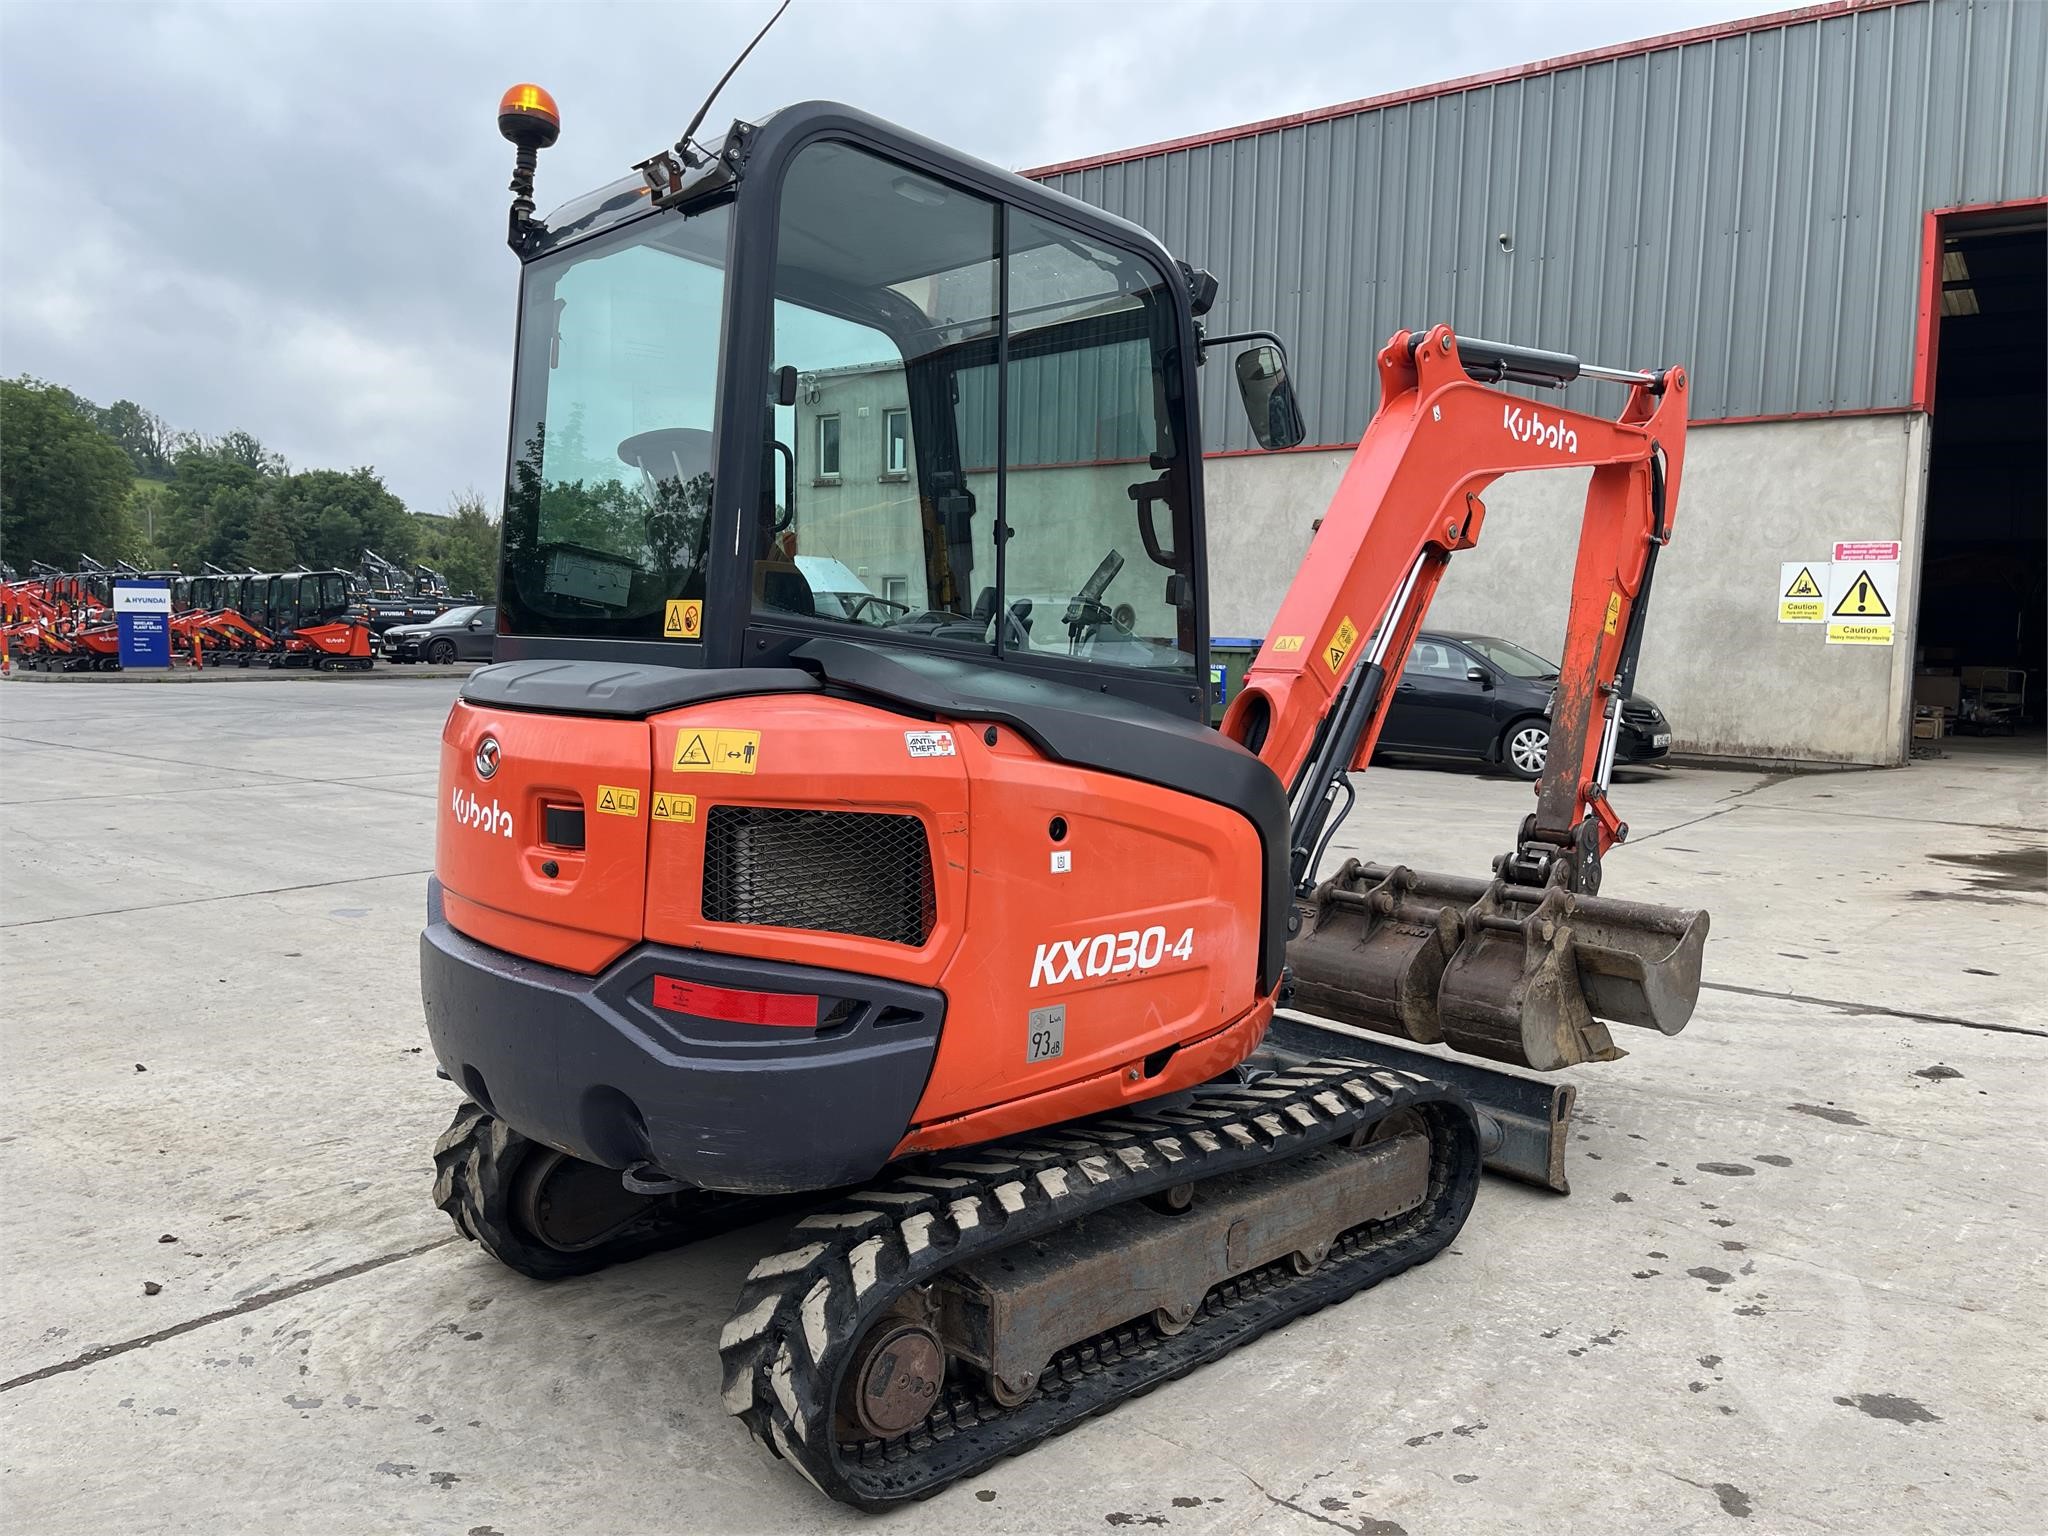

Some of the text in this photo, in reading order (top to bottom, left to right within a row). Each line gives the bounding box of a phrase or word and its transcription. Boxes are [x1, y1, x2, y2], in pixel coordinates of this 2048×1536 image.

[1503, 404, 1577, 454] Kubota
[1843, 626, 1878, 634] Caution
[452, 786, 513, 838] Kubota
[1029, 925, 1194, 988] KX030-4
[1032, 1030, 1060, 1058] 93 dB
